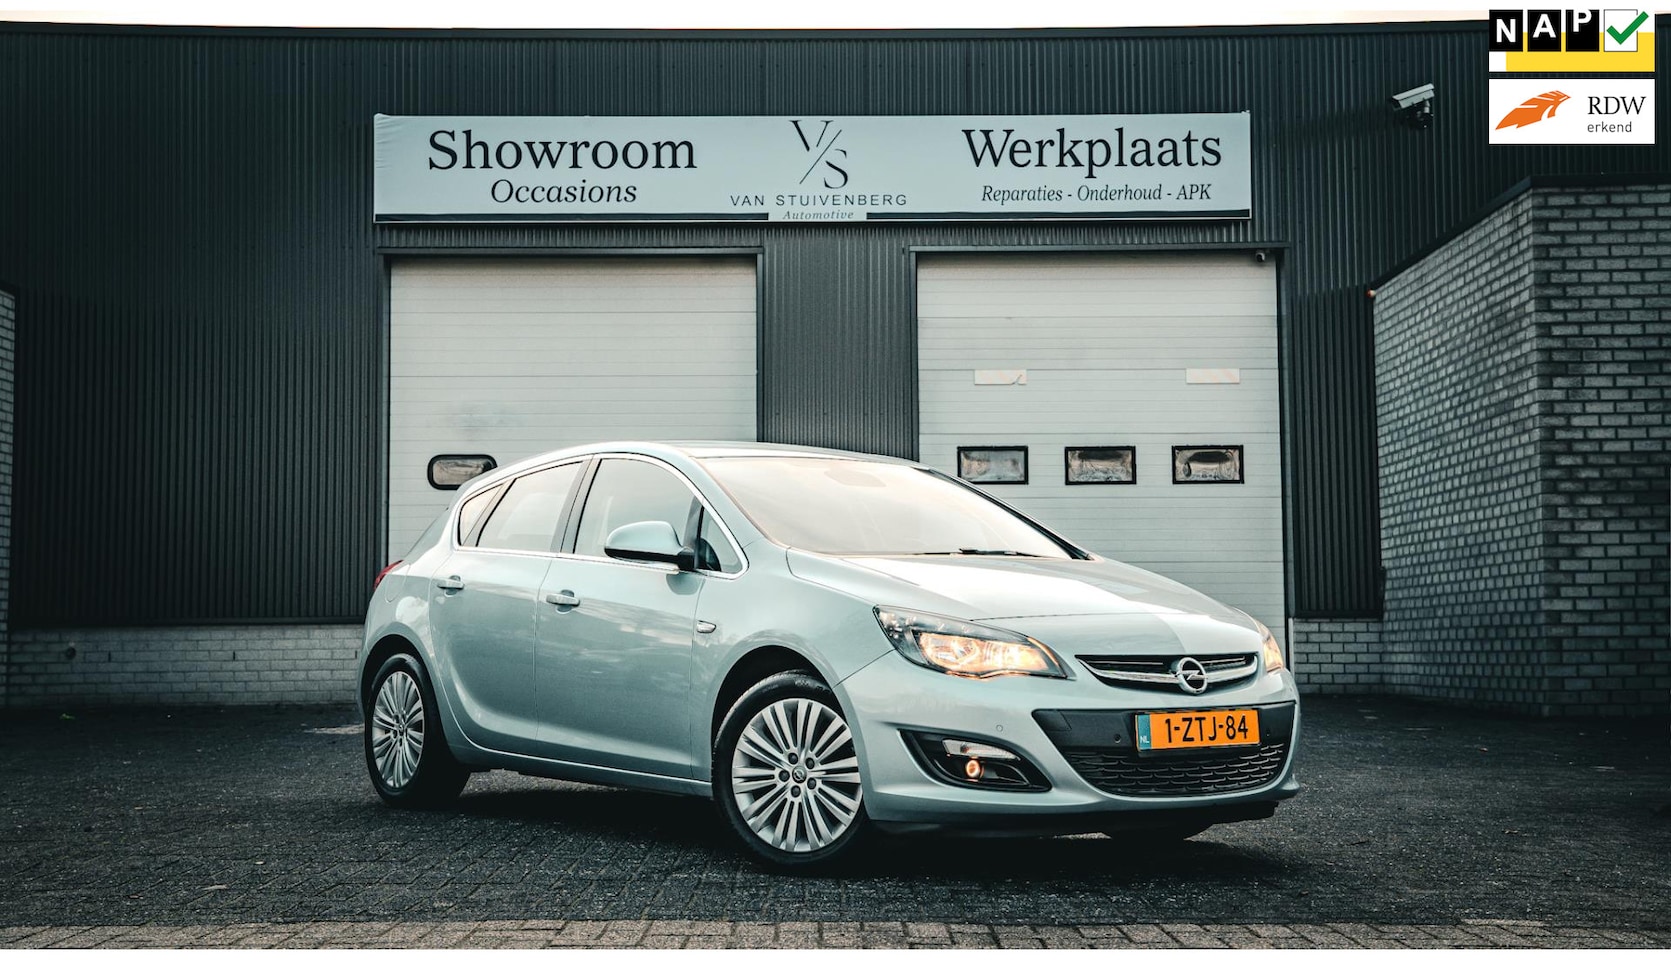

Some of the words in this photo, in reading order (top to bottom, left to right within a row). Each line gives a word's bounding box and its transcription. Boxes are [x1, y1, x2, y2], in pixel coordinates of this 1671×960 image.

[428, 129, 698, 170] Showroom
[962, 127, 1222, 178] Werkplaats
[491, 179, 637, 203] Occasions
[730, 195, 765, 206] VAN
[776, 194, 907, 206] STUIVENBERG
[982, 185, 1063, 205] Reparaties
[1077, 184, 1162, 201] Onderhoud
[1176, 184, 1212, 200] APK
[783, 209, 854, 220] Automotive
[1140, 736, 1150, 744] NL
[1165, 715, 1248, 744] 1-ZTJ-84
